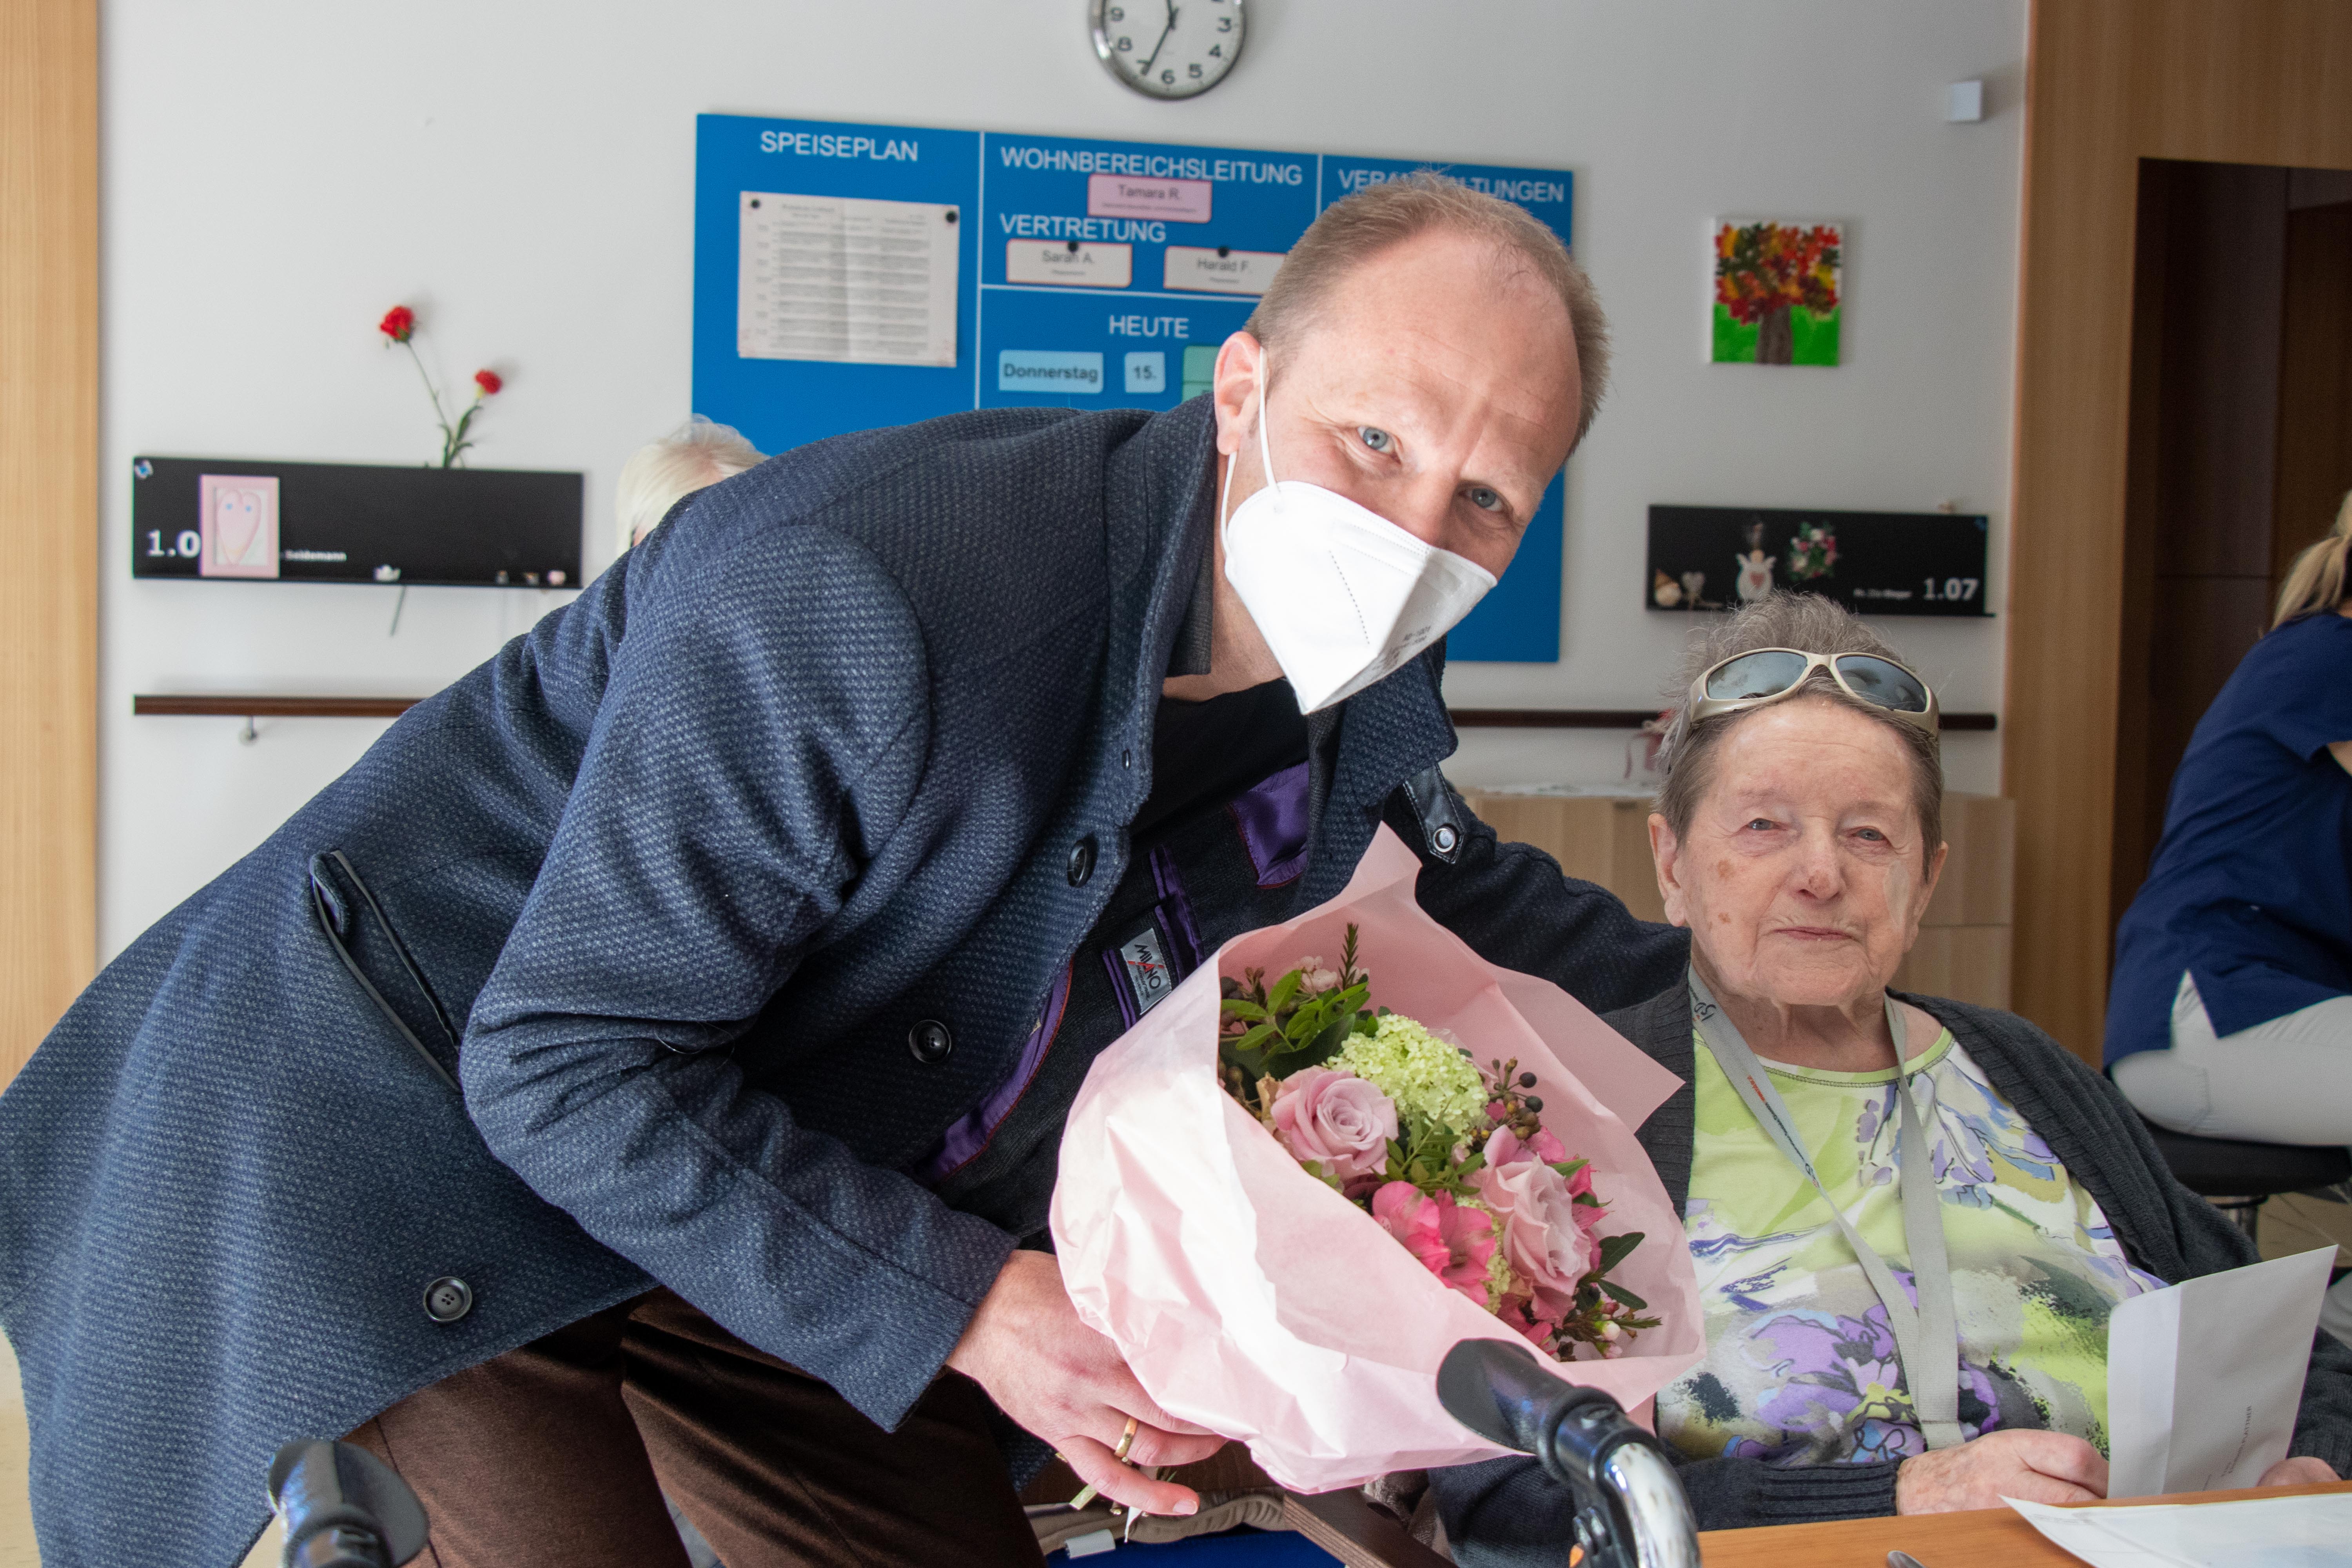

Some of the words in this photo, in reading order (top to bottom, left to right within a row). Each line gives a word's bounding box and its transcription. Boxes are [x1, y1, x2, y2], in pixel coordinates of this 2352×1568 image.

[1218, 17, 1231, 32] 3
[1209, 44, 1221, 58] 4
[1161, 69, 1175, 84] 6
[1189, 63, 1202, 78] 5
[760, 131, 918, 162] SPEISEPLAN
[1000, 146, 1303, 185] WOHNBEREICHSLEITUNG
[1118, 185, 1165, 199] Tamara
[1000, 213, 1167, 242] VERTRETUNG
[1198, 258, 1236, 272] Harald
[1109, 314, 1189, 338] HEUTE
[1004, 363, 1098, 384] Donnerstag
[1134, 365, 1156, 379] 15.
[147, 530, 201, 558] 1.0
[1923, 577, 1979, 601] 1.07
